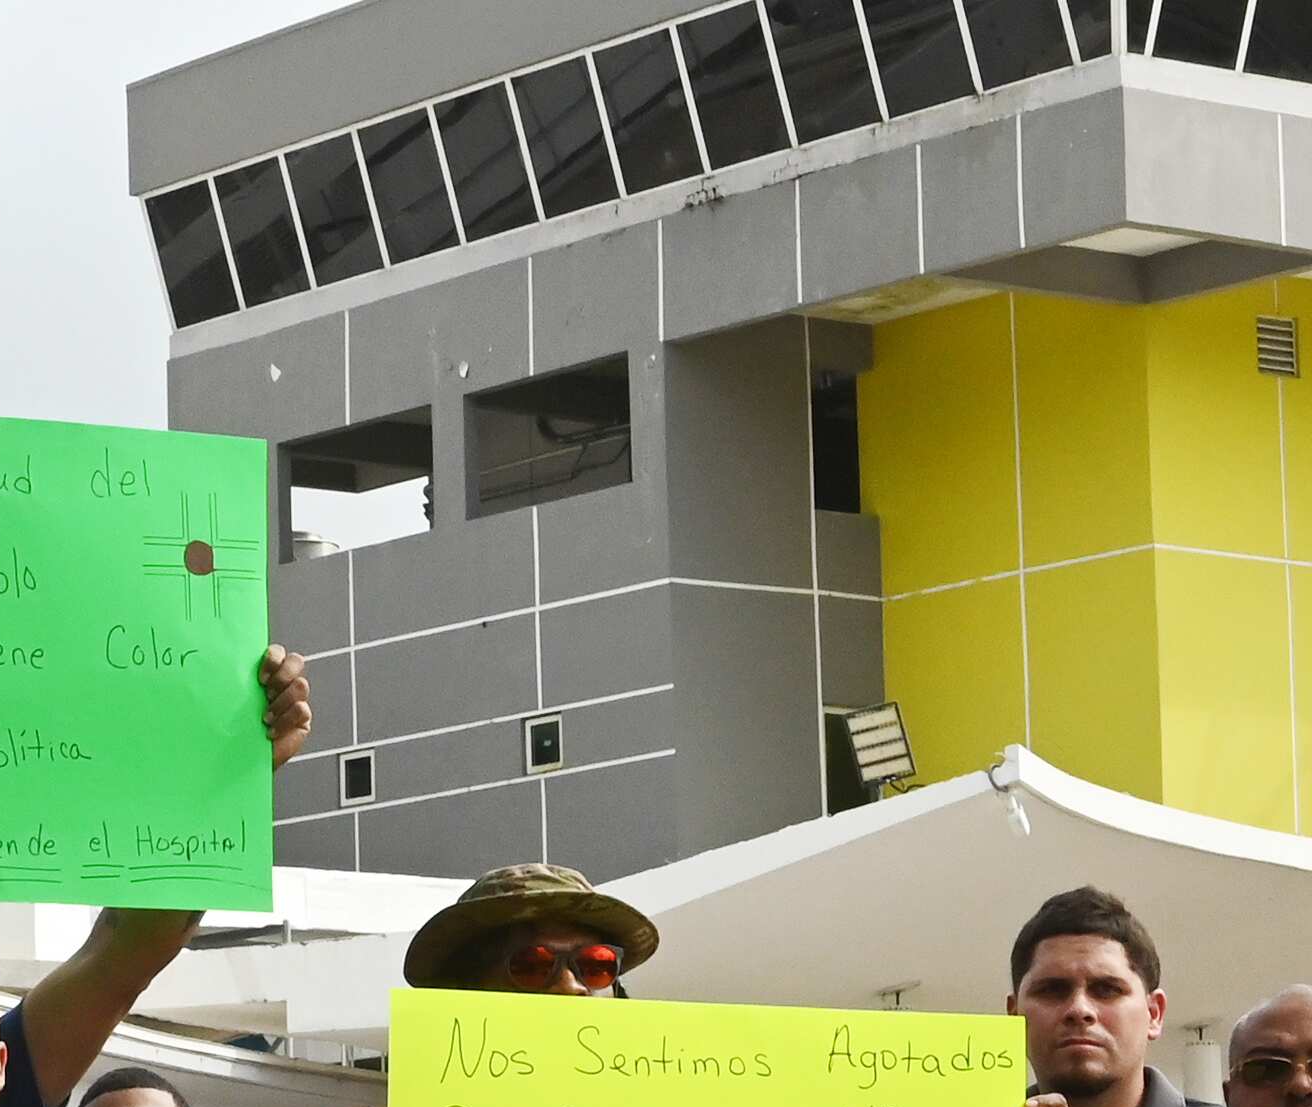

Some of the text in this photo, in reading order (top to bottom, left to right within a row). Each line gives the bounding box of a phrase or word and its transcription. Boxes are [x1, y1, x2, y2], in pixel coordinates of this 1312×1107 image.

[90, 447, 152, 499] del
[105, 624, 200, 669] Color
[88, 822, 111, 858] el
[440, 1017, 1014, 1090] Nos Sentimos Agotados
